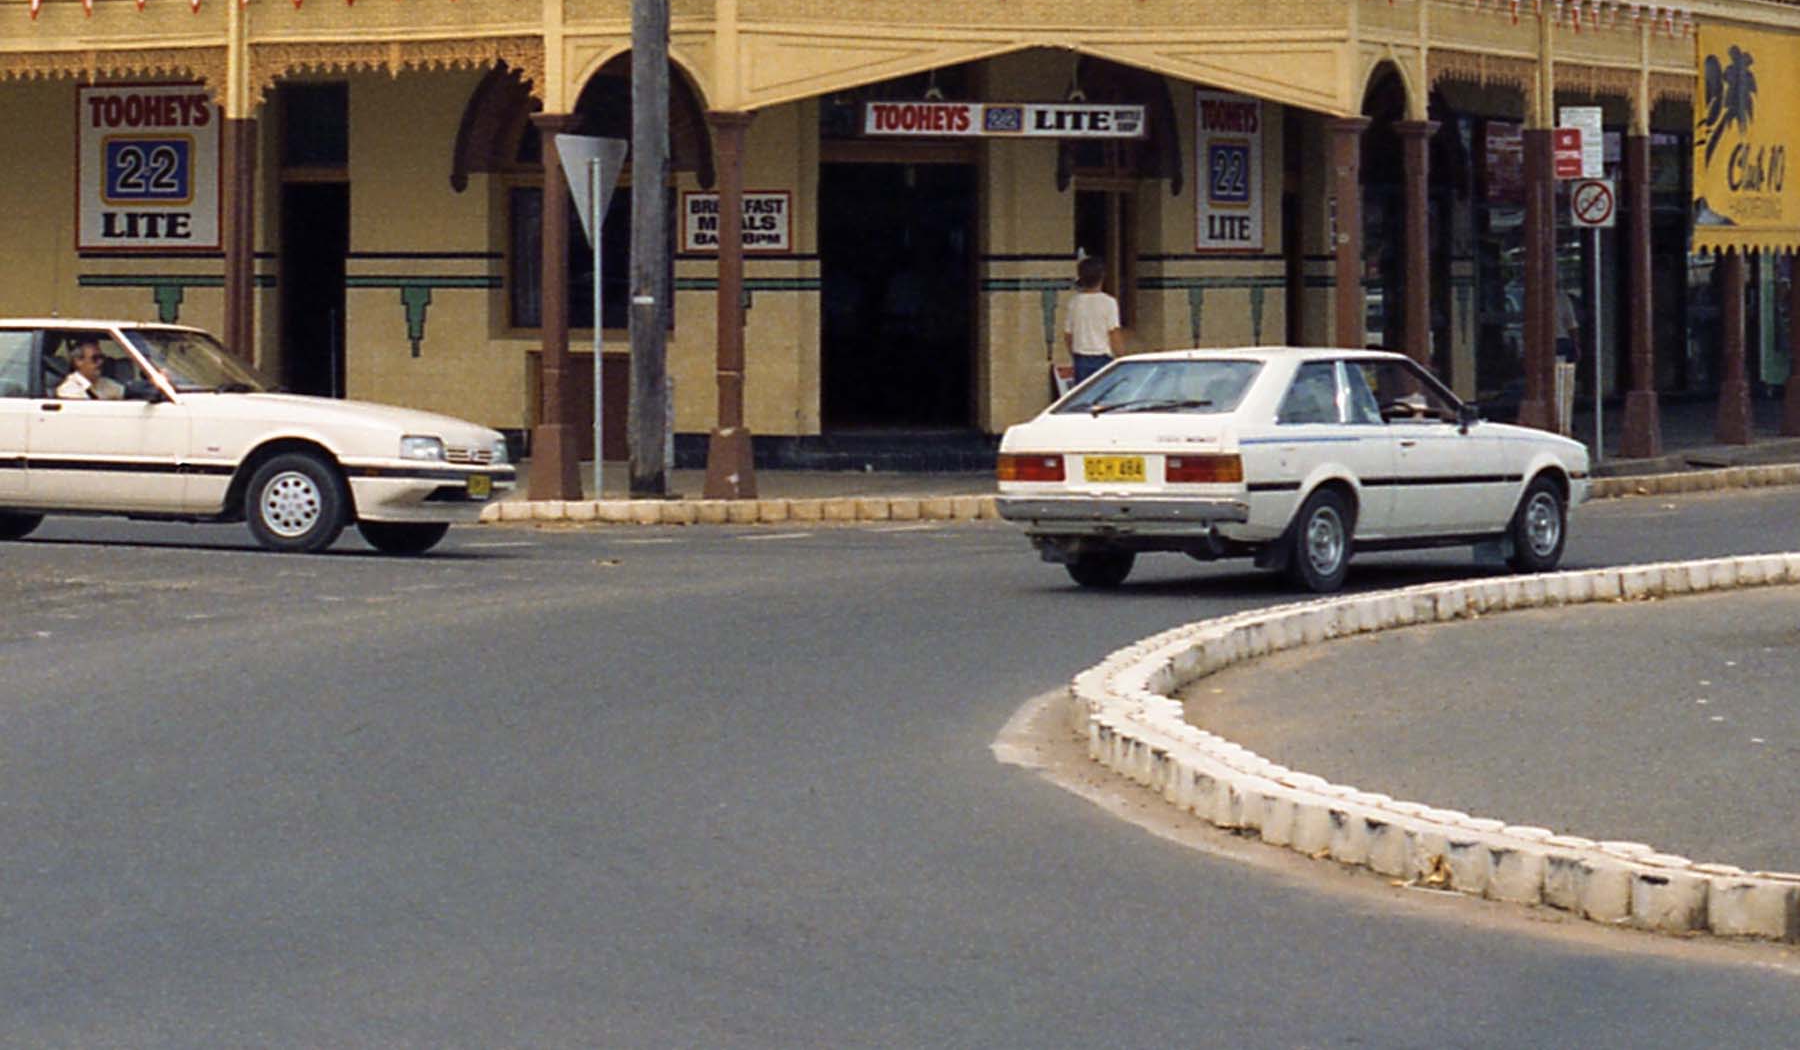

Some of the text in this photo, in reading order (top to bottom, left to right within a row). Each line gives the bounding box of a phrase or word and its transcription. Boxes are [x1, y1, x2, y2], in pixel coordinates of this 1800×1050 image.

[88, 93, 211, 128] TOOHEYS
[872, 104, 971, 132] TOOHEYS
[1034, 109, 1111, 131] LITE
[101, 211, 192, 239] LITE
[1208, 214, 1251, 241] LITE
